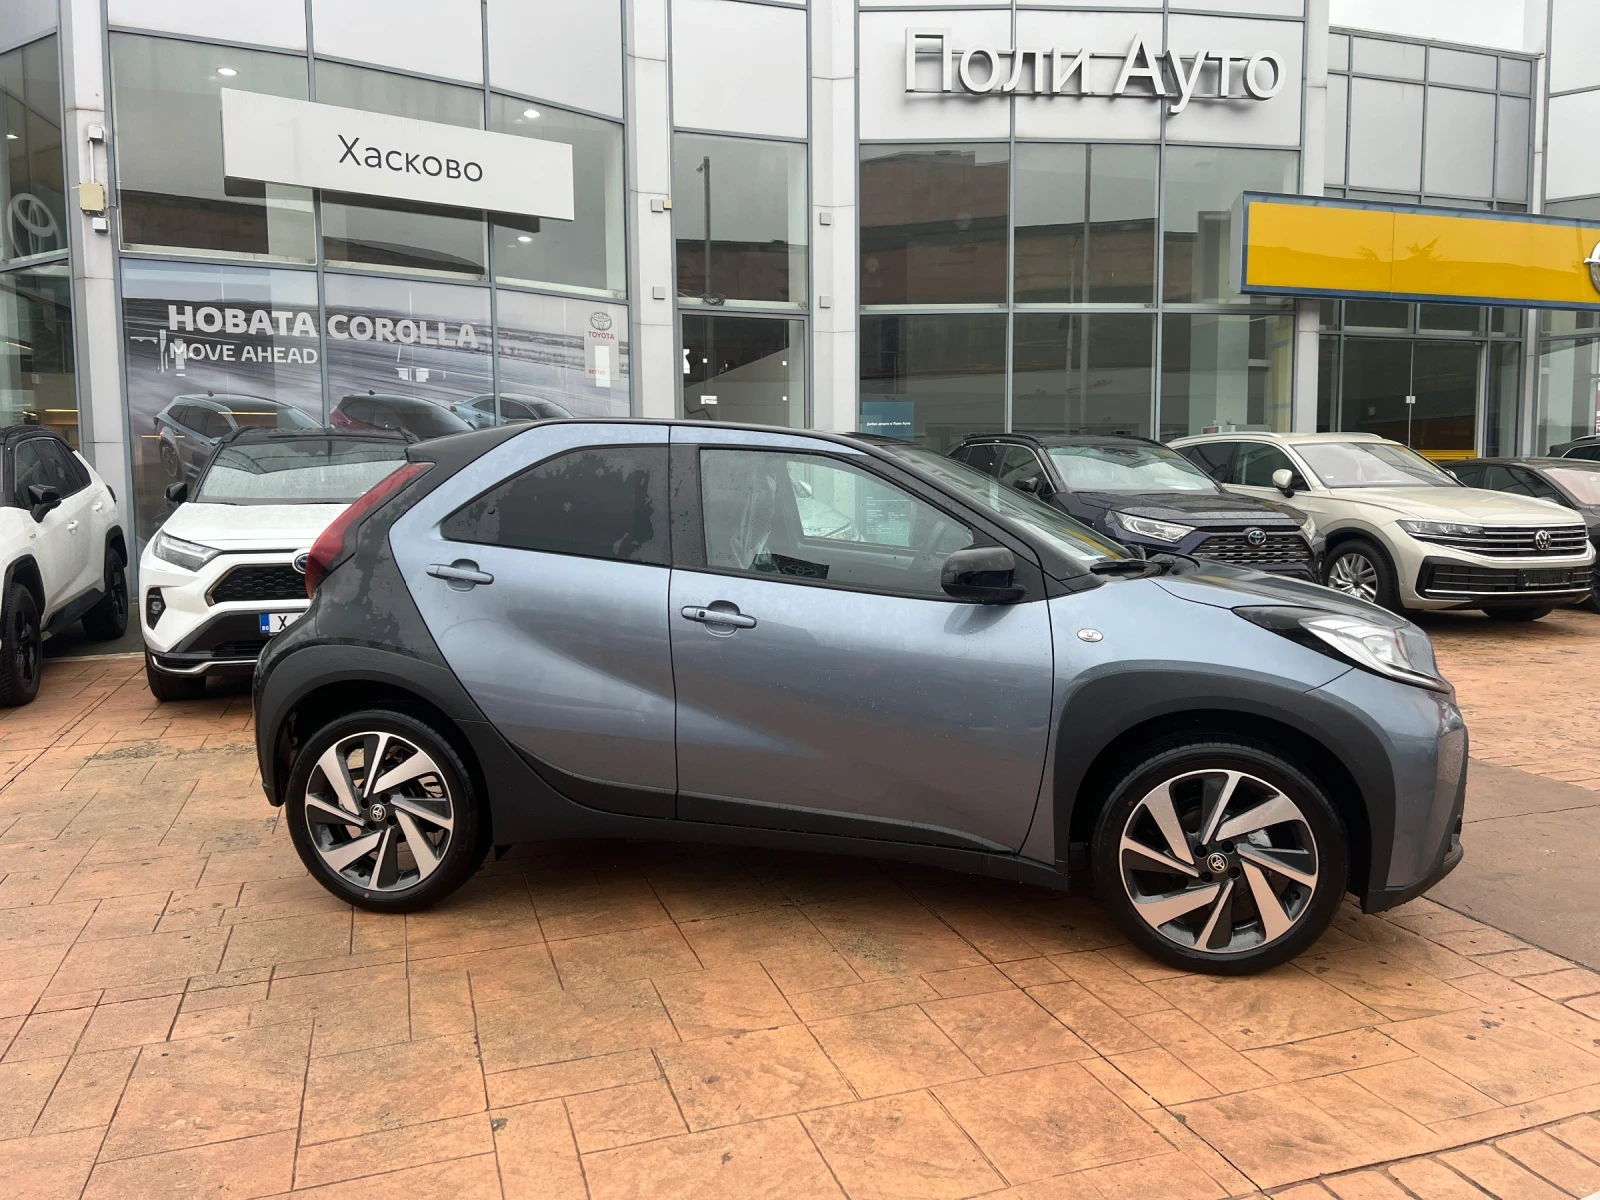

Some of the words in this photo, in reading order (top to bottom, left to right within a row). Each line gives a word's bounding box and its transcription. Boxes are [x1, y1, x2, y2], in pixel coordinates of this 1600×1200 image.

[905, 26, 1091, 96] Поли
[1113, 32, 1287, 115] Ауто
[337, 134, 483, 182] Хасково
[168, 304, 318, 337] НОВАТА
[327, 314, 479, 348] COROLLA
[588, 331, 614, 340] TOYOTA
[169, 342, 236, 361] MOVE
[241, 345, 318, 364] AHEAD
